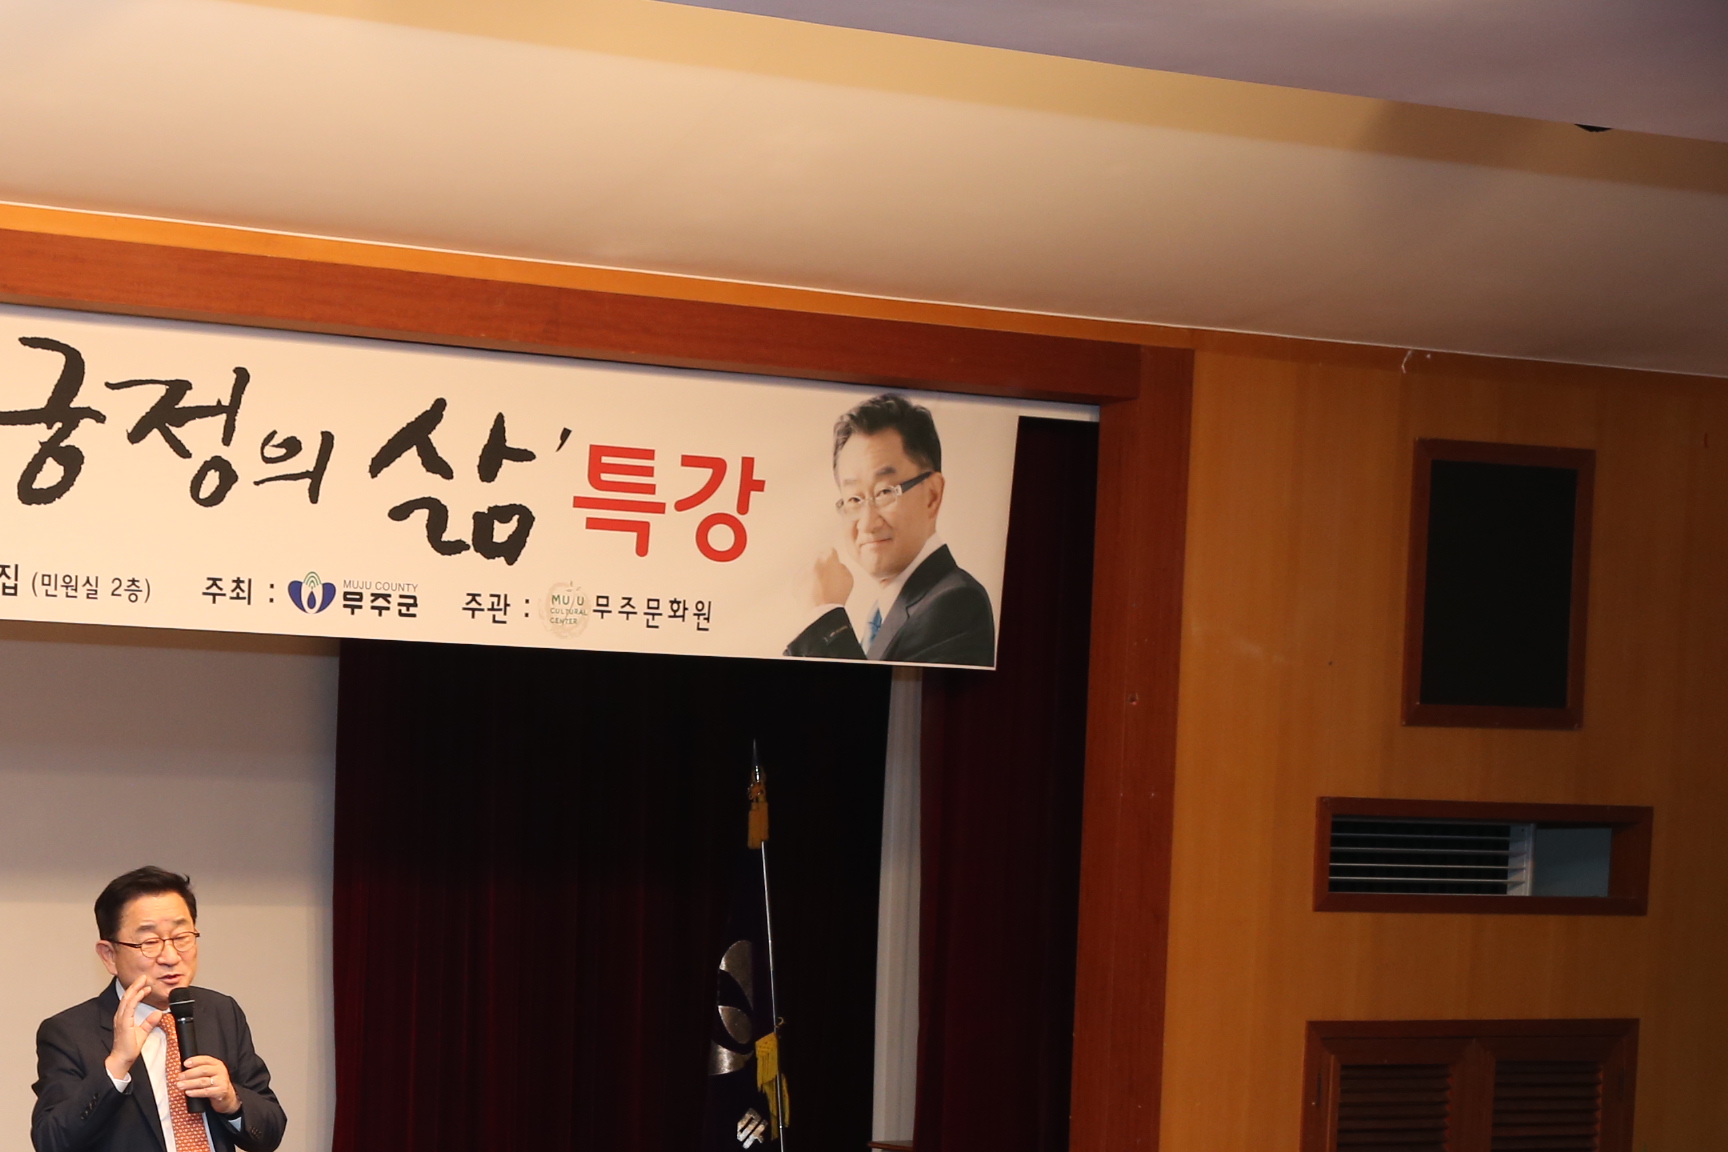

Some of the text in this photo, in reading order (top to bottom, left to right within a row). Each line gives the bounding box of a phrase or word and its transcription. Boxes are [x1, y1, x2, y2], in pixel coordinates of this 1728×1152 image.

[573, 444, 765, 562] 특강
[32, 571, 98, 600] (민원실
[111, 577, 151, 603] 2층)
[202, 577, 252, 605] 주최
[343, 579, 418, 592] MUJU COUNTY
[343, 591, 418, 618] 무주군
[462, 593, 511, 624] 주관
[592, 595, 712, 631] 무주문화원
